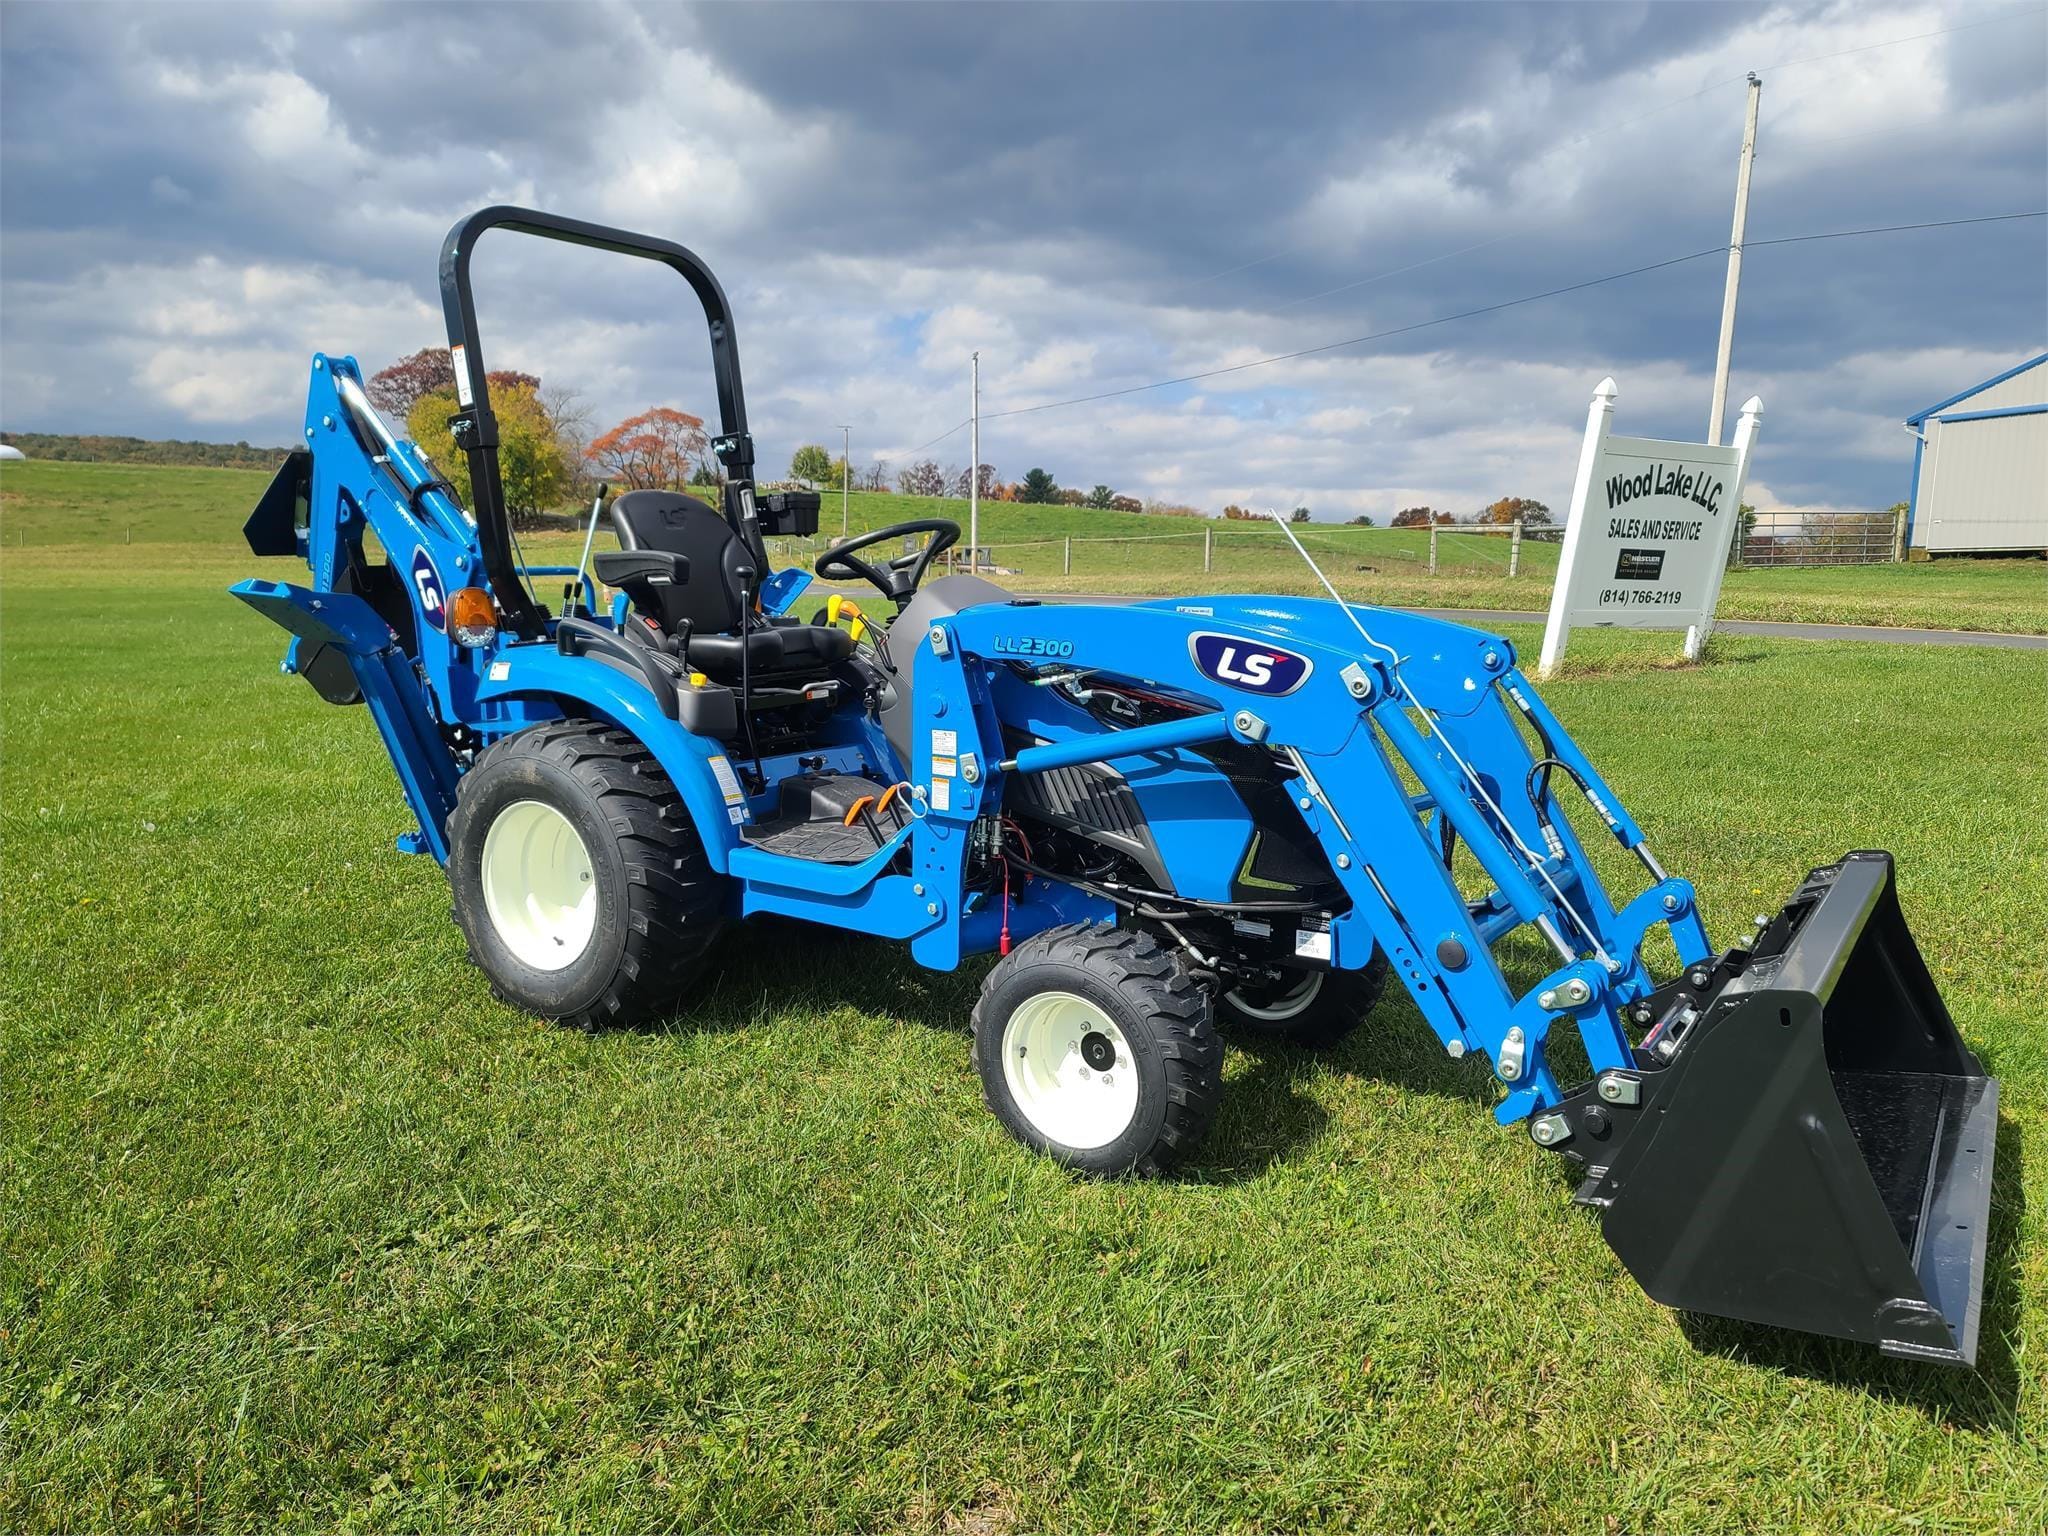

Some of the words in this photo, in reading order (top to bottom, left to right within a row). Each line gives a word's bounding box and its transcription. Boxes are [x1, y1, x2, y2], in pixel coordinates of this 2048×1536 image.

[1606, 464, 1654, 509] Wood
[1654, 463, 1693, 498] Lake
[1608, 518, 1640, 538] SALES
[1640, 519, 1661, 539] AND
[1661, 520, 1702, 540] SERVICE
[415, 568, 440, 611] LS
[1599, 589, 1629, 606] (814)
[1631, 590, 1682, 604] 766-2119
[993, 636, 1074, 658] LL2300
[1217, 647, 1275, 686] LS
